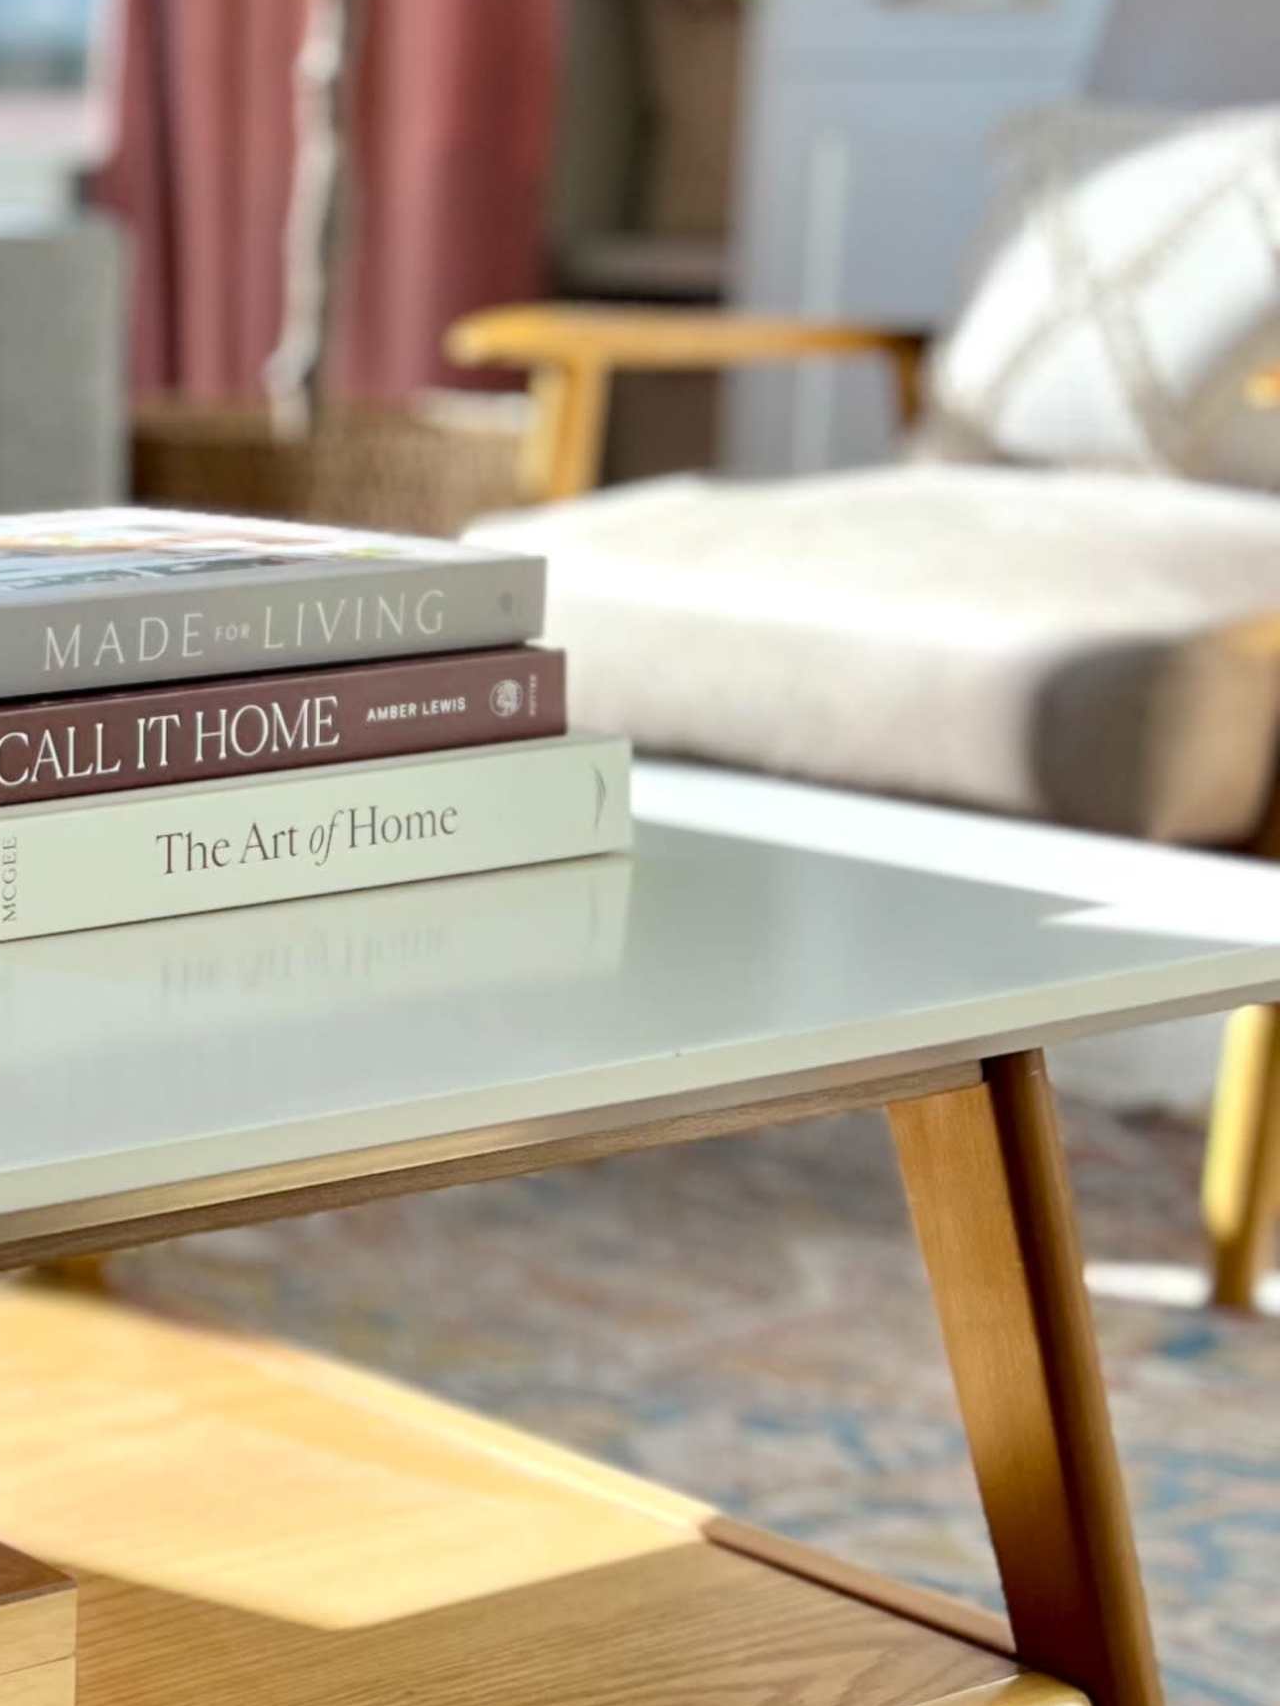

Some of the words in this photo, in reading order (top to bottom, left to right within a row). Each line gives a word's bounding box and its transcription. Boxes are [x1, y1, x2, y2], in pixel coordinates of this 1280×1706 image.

[43, 612, 204, 671] MADE
[214, 622, 251, 643] FOR
[263, 589, 445, 650] LIVING
[136, 713, 182, 770] IT
[194, 695, 341, 763] HOME
[366, 702, 418, 723] AMBER
[421, 696, 467, 716] LEWIS
[155, 830, 232, 876] The
[239, 821, 299, 865] Art
[308, 808, 345, 868] of
[348, 805, 458, 849] Home
